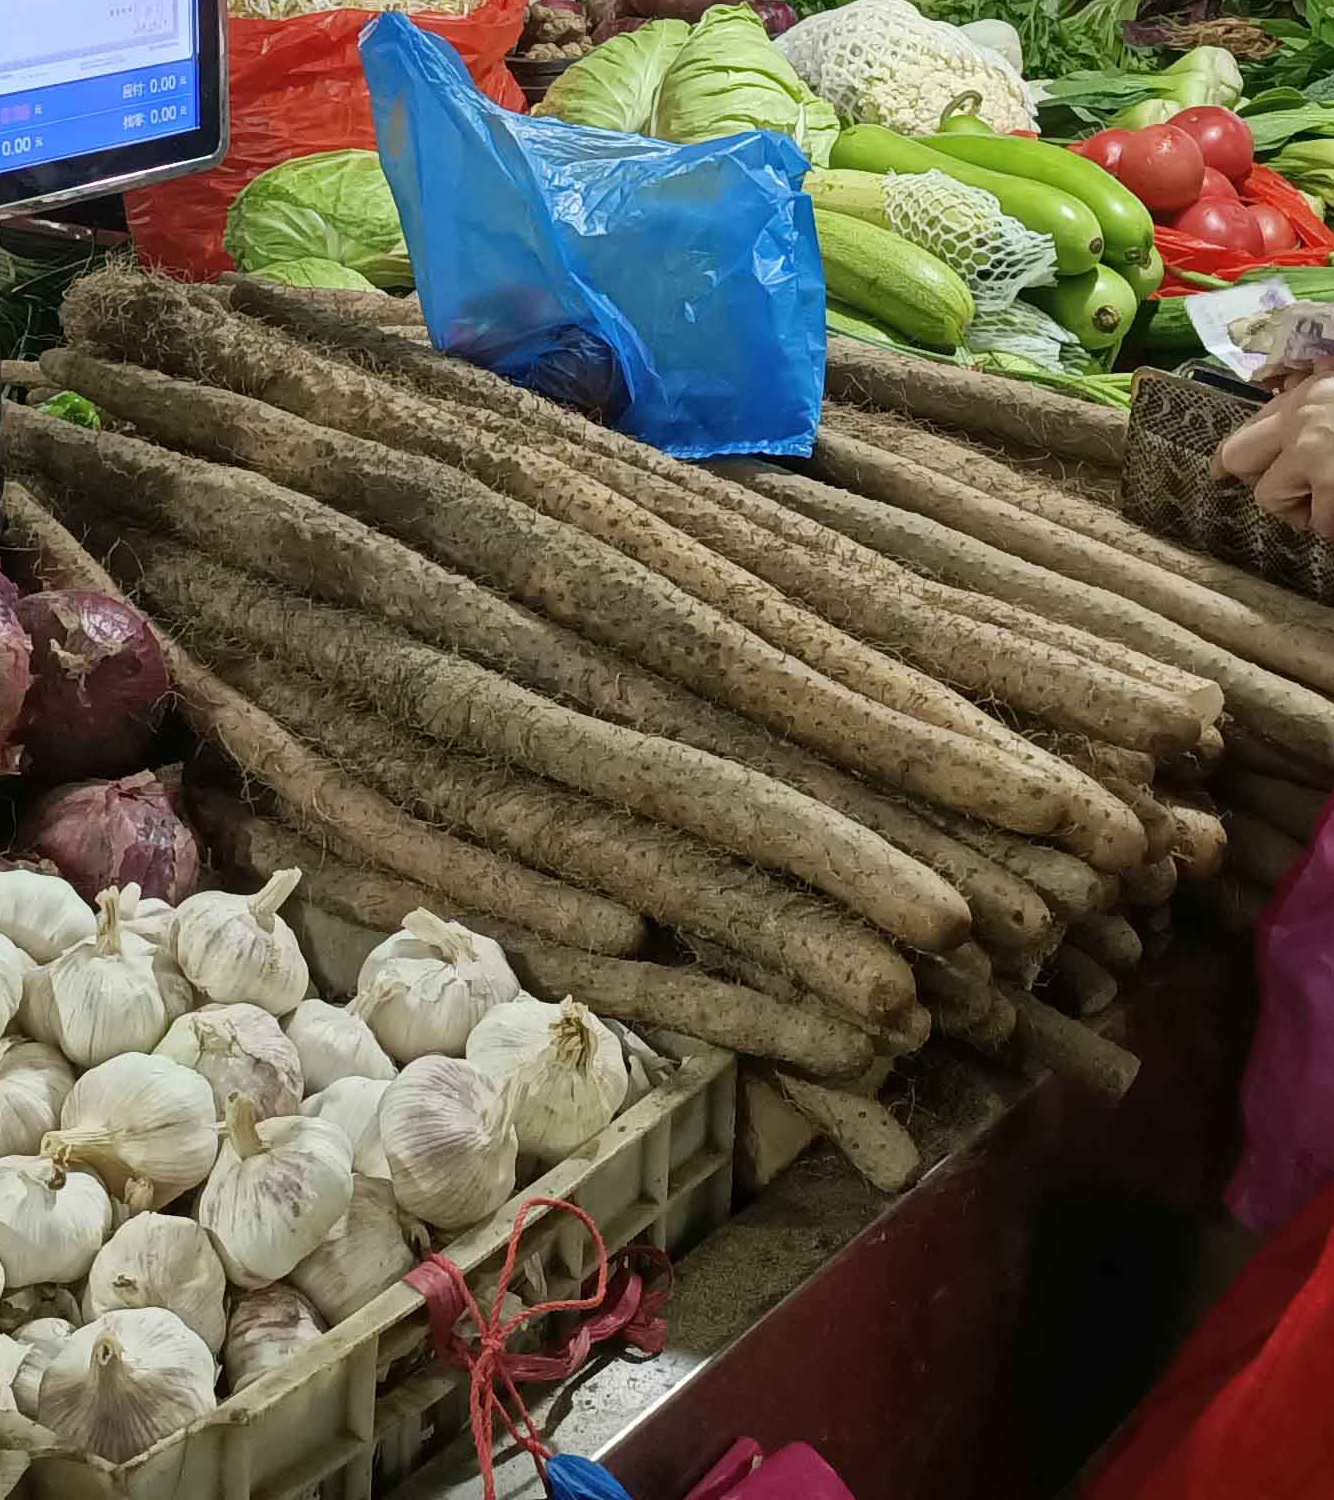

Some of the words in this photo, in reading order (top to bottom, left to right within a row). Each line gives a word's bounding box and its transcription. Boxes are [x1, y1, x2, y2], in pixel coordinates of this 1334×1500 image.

[149, 75, 177, 94] 0.00
[149, 105, 177, 125] 0.00
[1, 136, 31, 156] 0.00
